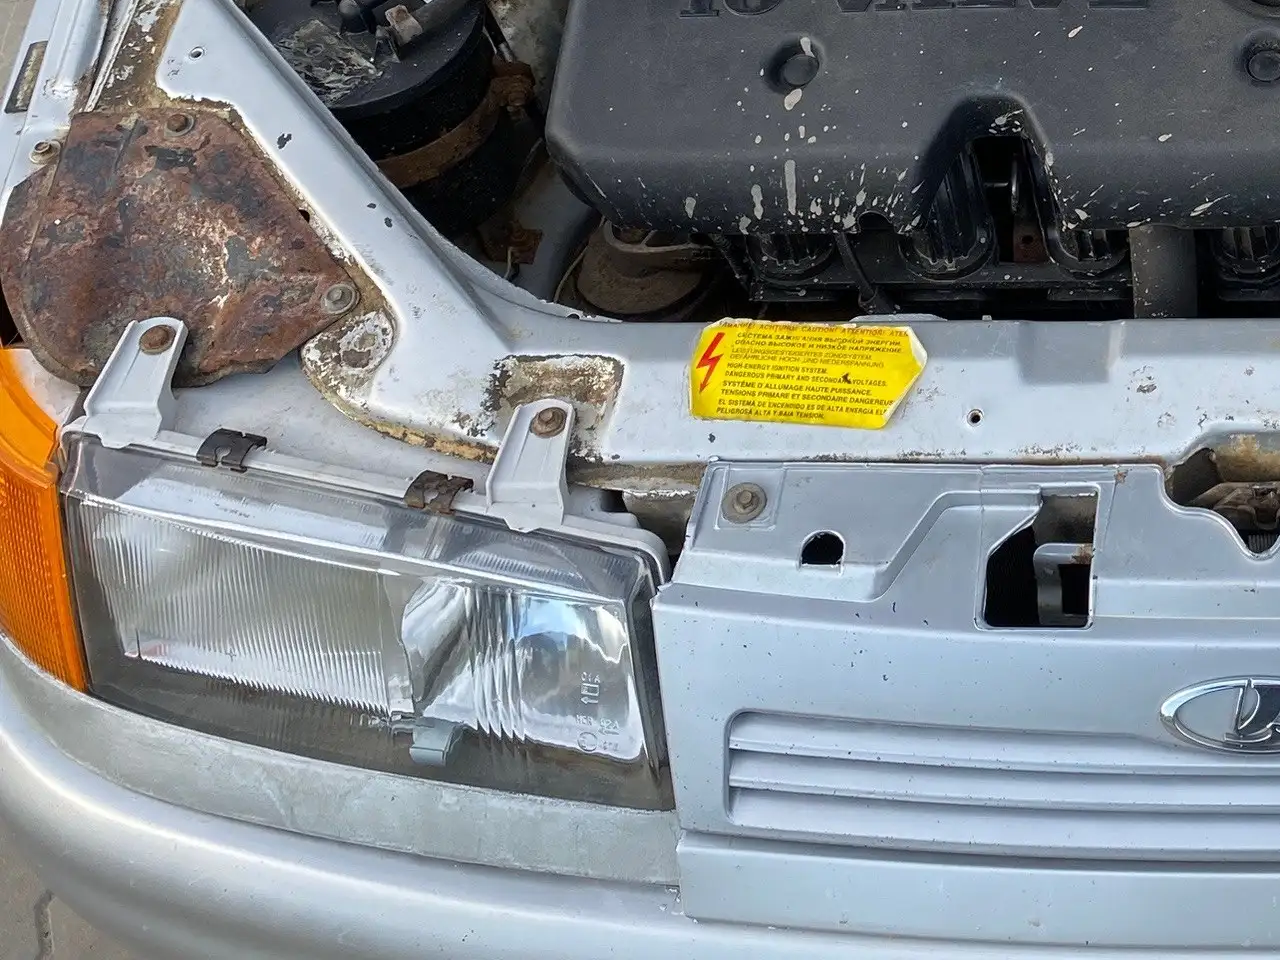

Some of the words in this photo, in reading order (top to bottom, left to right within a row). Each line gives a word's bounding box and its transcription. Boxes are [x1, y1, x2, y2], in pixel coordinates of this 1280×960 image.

[772, 364, 800, 372] IGNITION
[725, 370, 764, 378] DANGEROUS
[766, 373, 796, 381] PRIMARY
[852, 379, 888, 387] VOLTAGES.
[805, 385, 829, 393] HAUTE
[721, 388, 757, 397] TENSIONS
[801, 394, 849, 402] SECONDAIRE
[716, 407, 753, 415] PELIGROSA
[728, 399, 756, 407] SISTEMA
[757, 400, 766, 408] DE
[768, 401, 806, 410] ENCENDIDO
[827, 405, 844, 413] ALTA
[845, 406, 874, 415] ENERGIA
